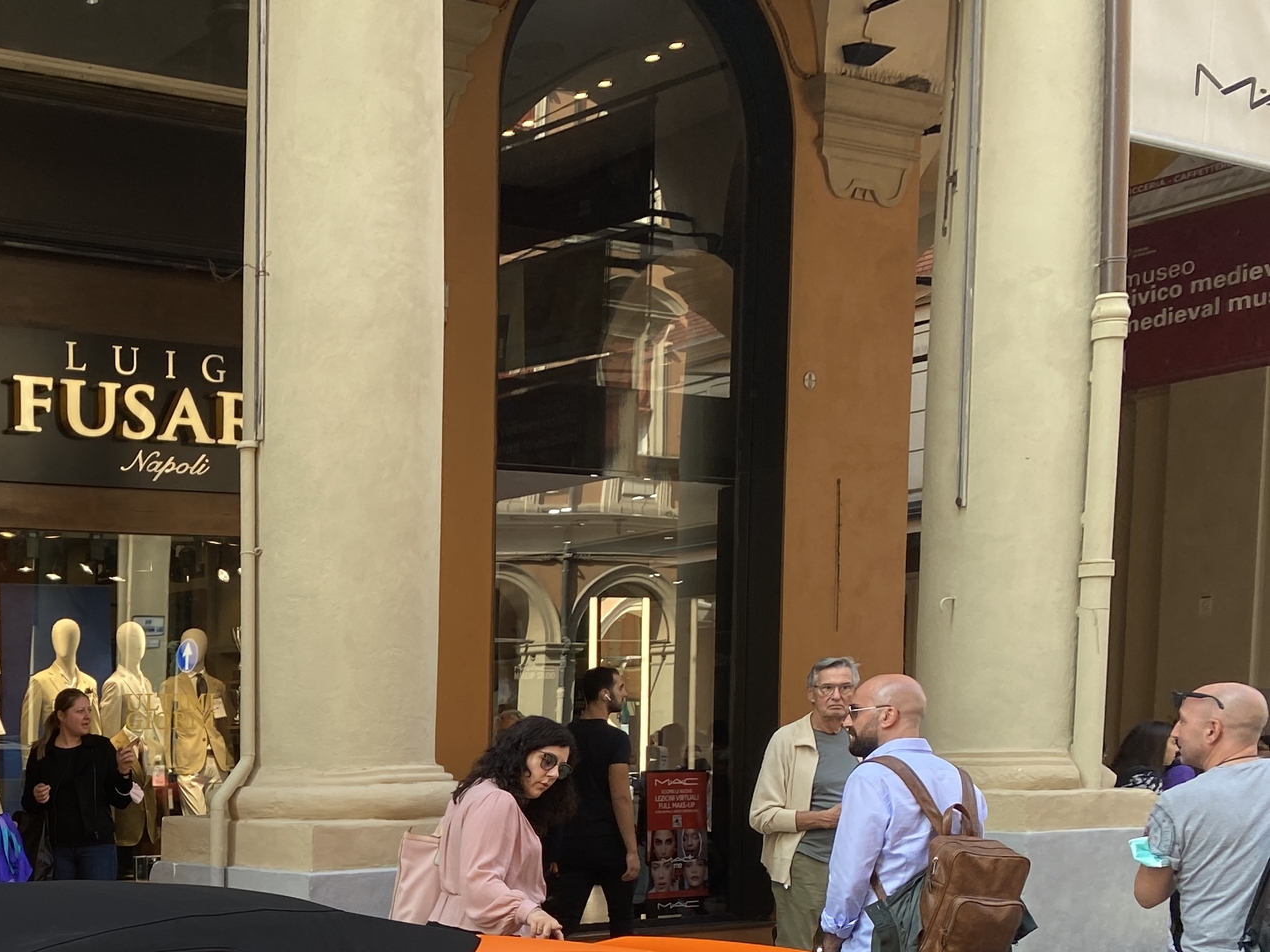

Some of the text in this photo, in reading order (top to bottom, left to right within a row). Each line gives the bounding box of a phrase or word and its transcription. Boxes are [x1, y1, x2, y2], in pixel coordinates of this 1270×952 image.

[1127, 260, 1195, 287] museo
[1128, 283, 1183, 308] ivico
[1228, 292, 1270, 312] mu
[120, 450, 210, 481] Napoli
